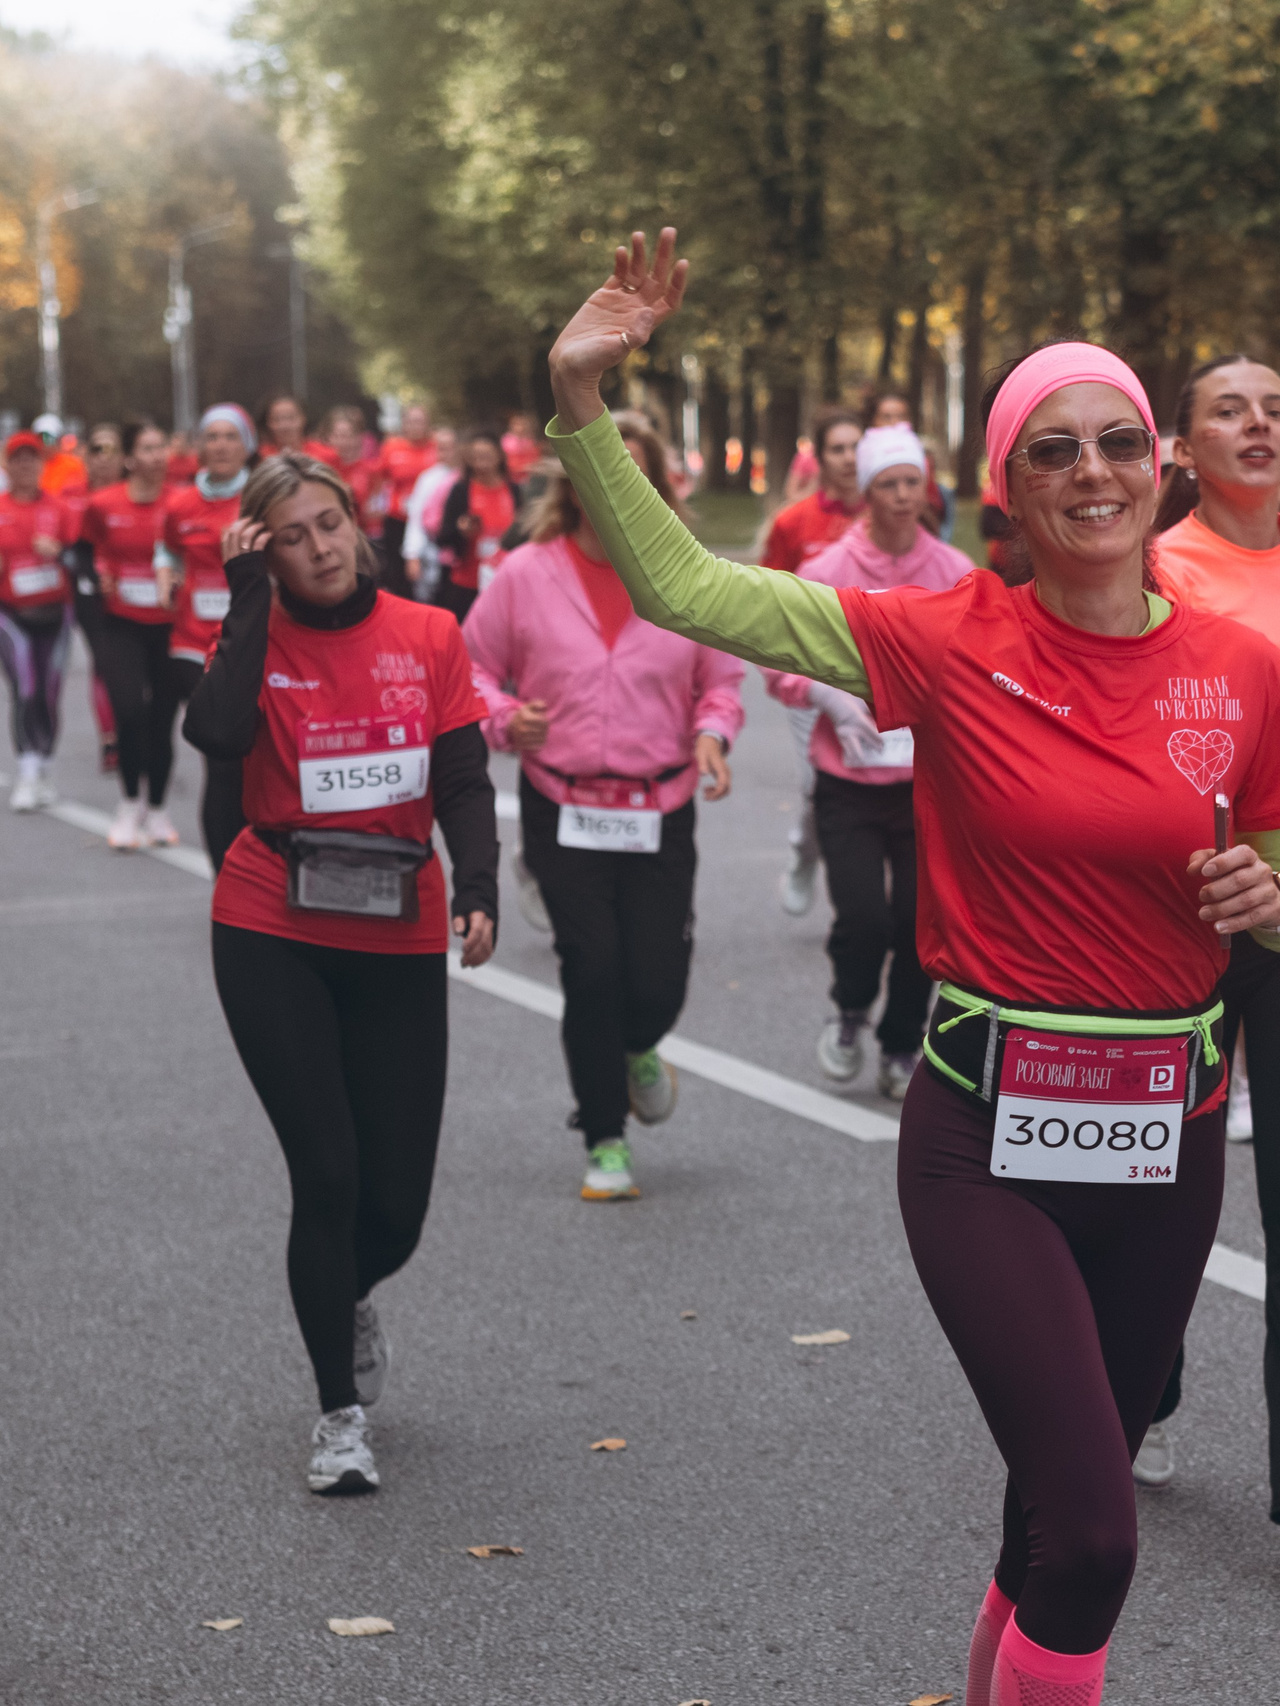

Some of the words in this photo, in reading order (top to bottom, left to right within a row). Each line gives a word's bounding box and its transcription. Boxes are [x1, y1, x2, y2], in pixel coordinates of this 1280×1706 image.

[1168, 677, 1199, 699] БЕГИ
[1203, 675, 1229, 698] КАК
[1154, 697, 1243, 721] ЧУВСТВУЕШЬ
[316, 764, 402, 793] 31558
[571, 813, 640, 837] 31676
[1015, 1058, 1077, 1087] РОЗОВЫЙ
[1077, 1066, 1115, 1090] ЗАБЕГ
[1153, 1067, 1171, 1085] D
[1005, 1113, 1170, 1151] 30080
[1128, 1165, 1138, 1178] 3
[1143, 1165, 1170, 1179] КМ
